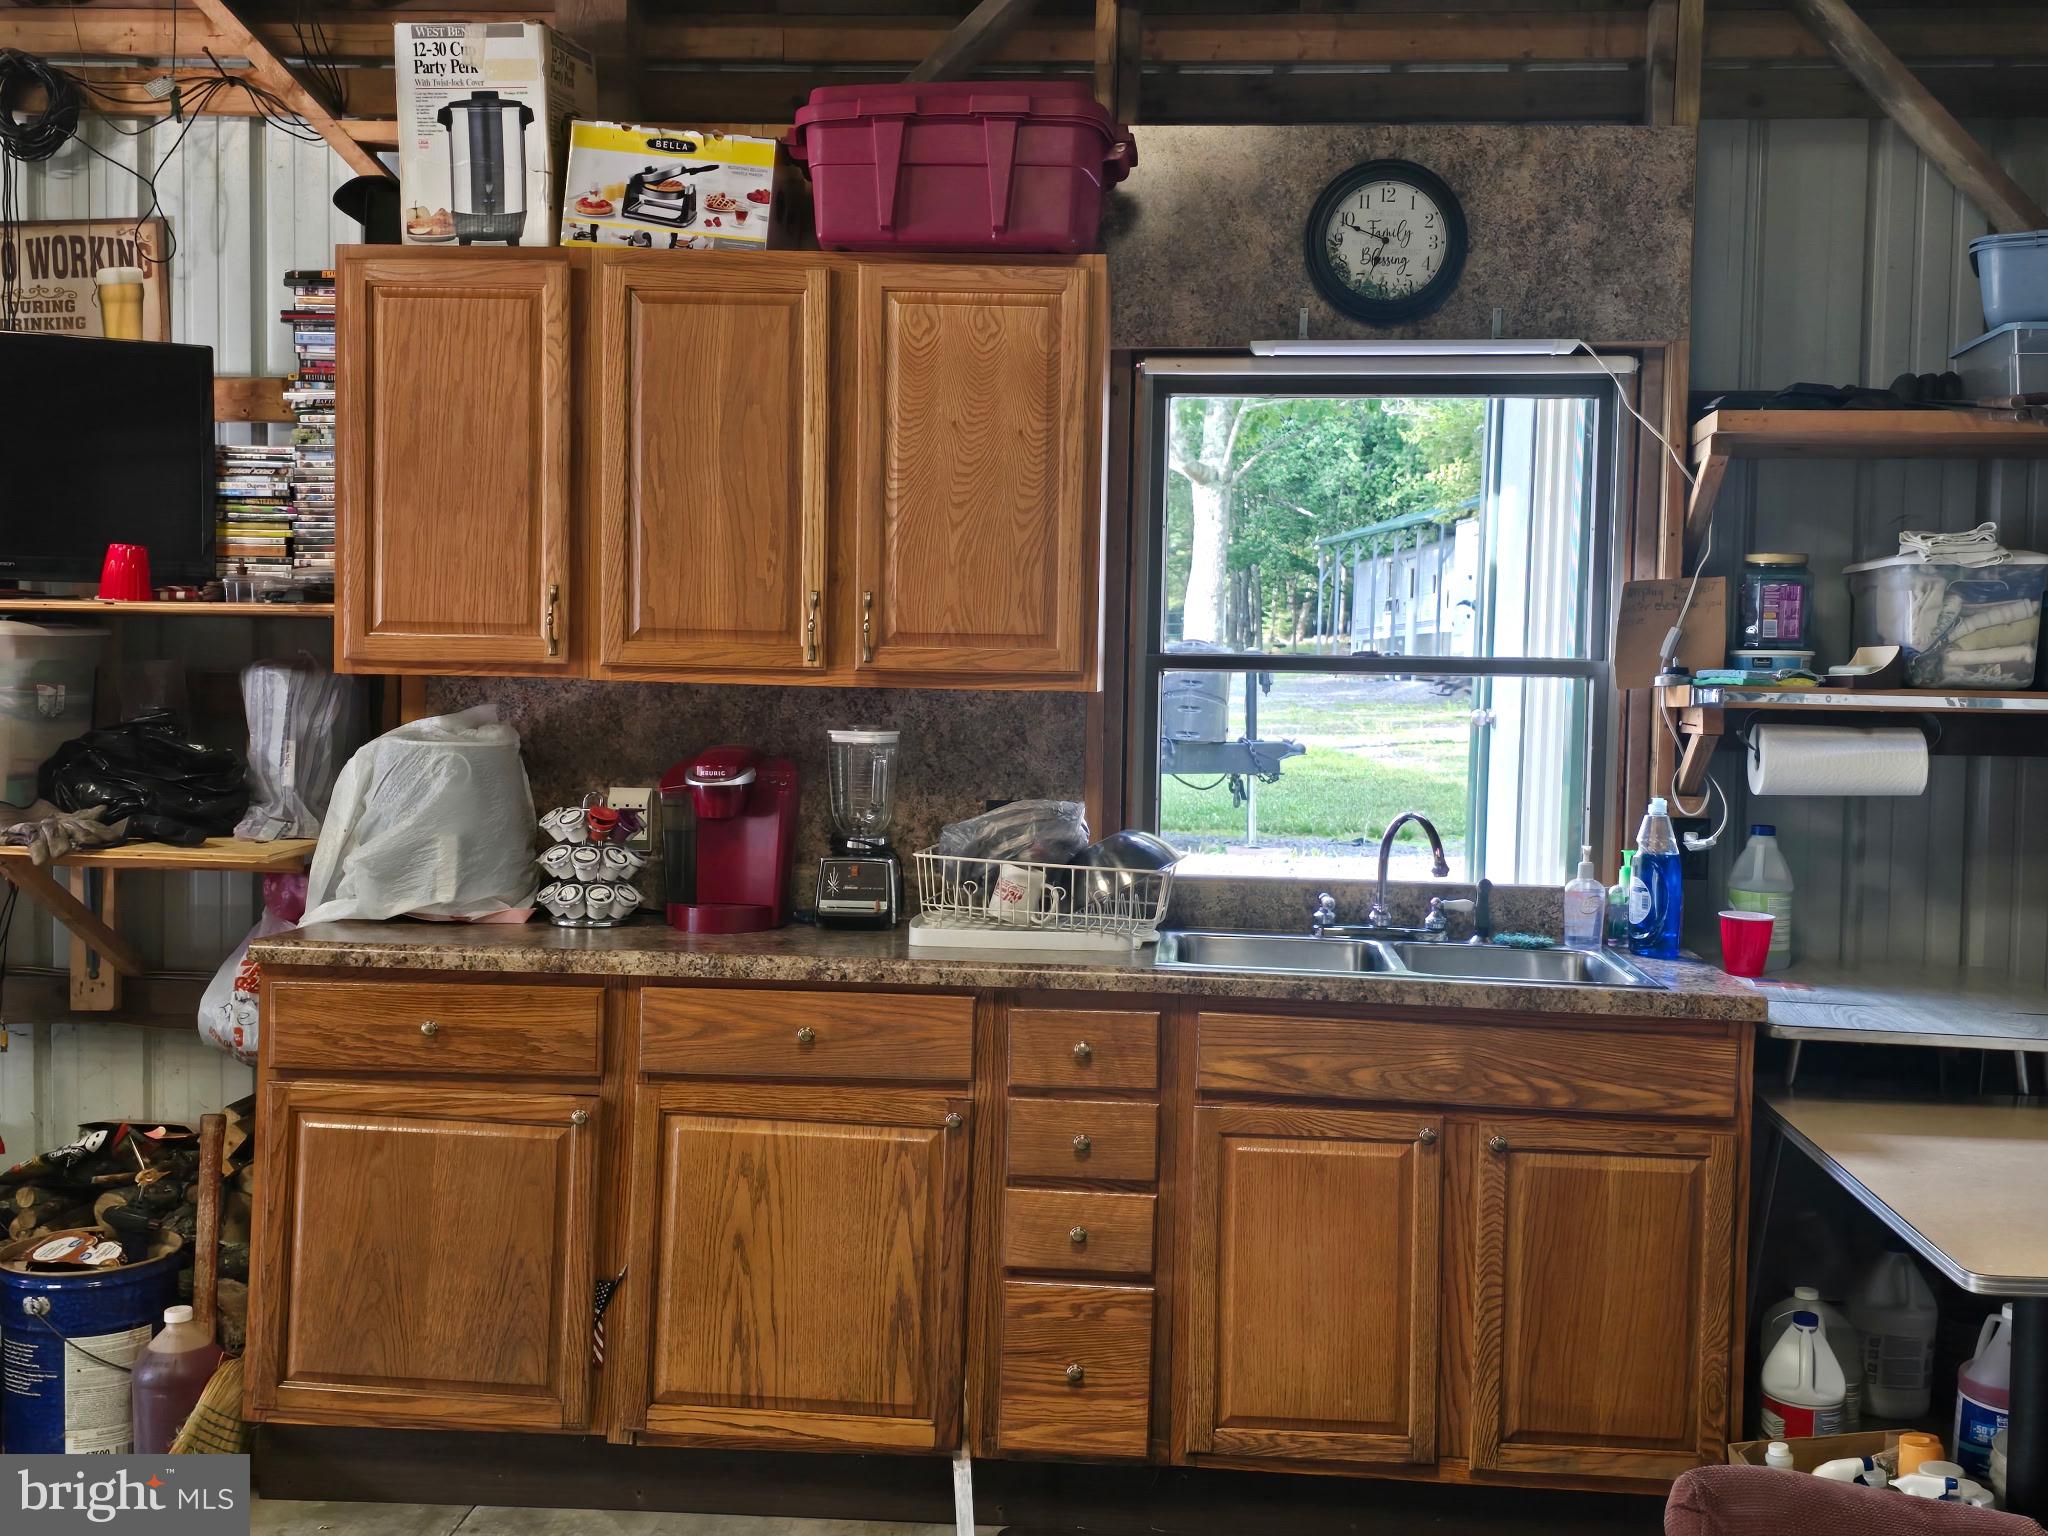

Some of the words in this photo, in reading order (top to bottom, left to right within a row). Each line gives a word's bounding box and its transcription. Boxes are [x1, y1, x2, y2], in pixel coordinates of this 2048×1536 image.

[415, 25, 445, 37] WEST
[413, 41, 446, 57] 12-30
[414, 59, 446, 77] Party
[414, 78, 430, 86] With
[432, 78, 464, 87] Twist-lock
[465, 78, 484, 87] Cover
[655, 140, 688, 151] BELLA
[1359, 194, 1371, 209] 11
[1381, 187, 1396, 203] 12
[1411, 195, 1416, 210] 1
[1340, 212, 1355, 227] 10
[1424, 213, 1434, 228] 2
[1367, 219, 1413, 248] Family
[1429, 234, 1438, 249] 3
[25, 235, 153, 280] WORKING
[1421, 256, 1430, 271] 4
